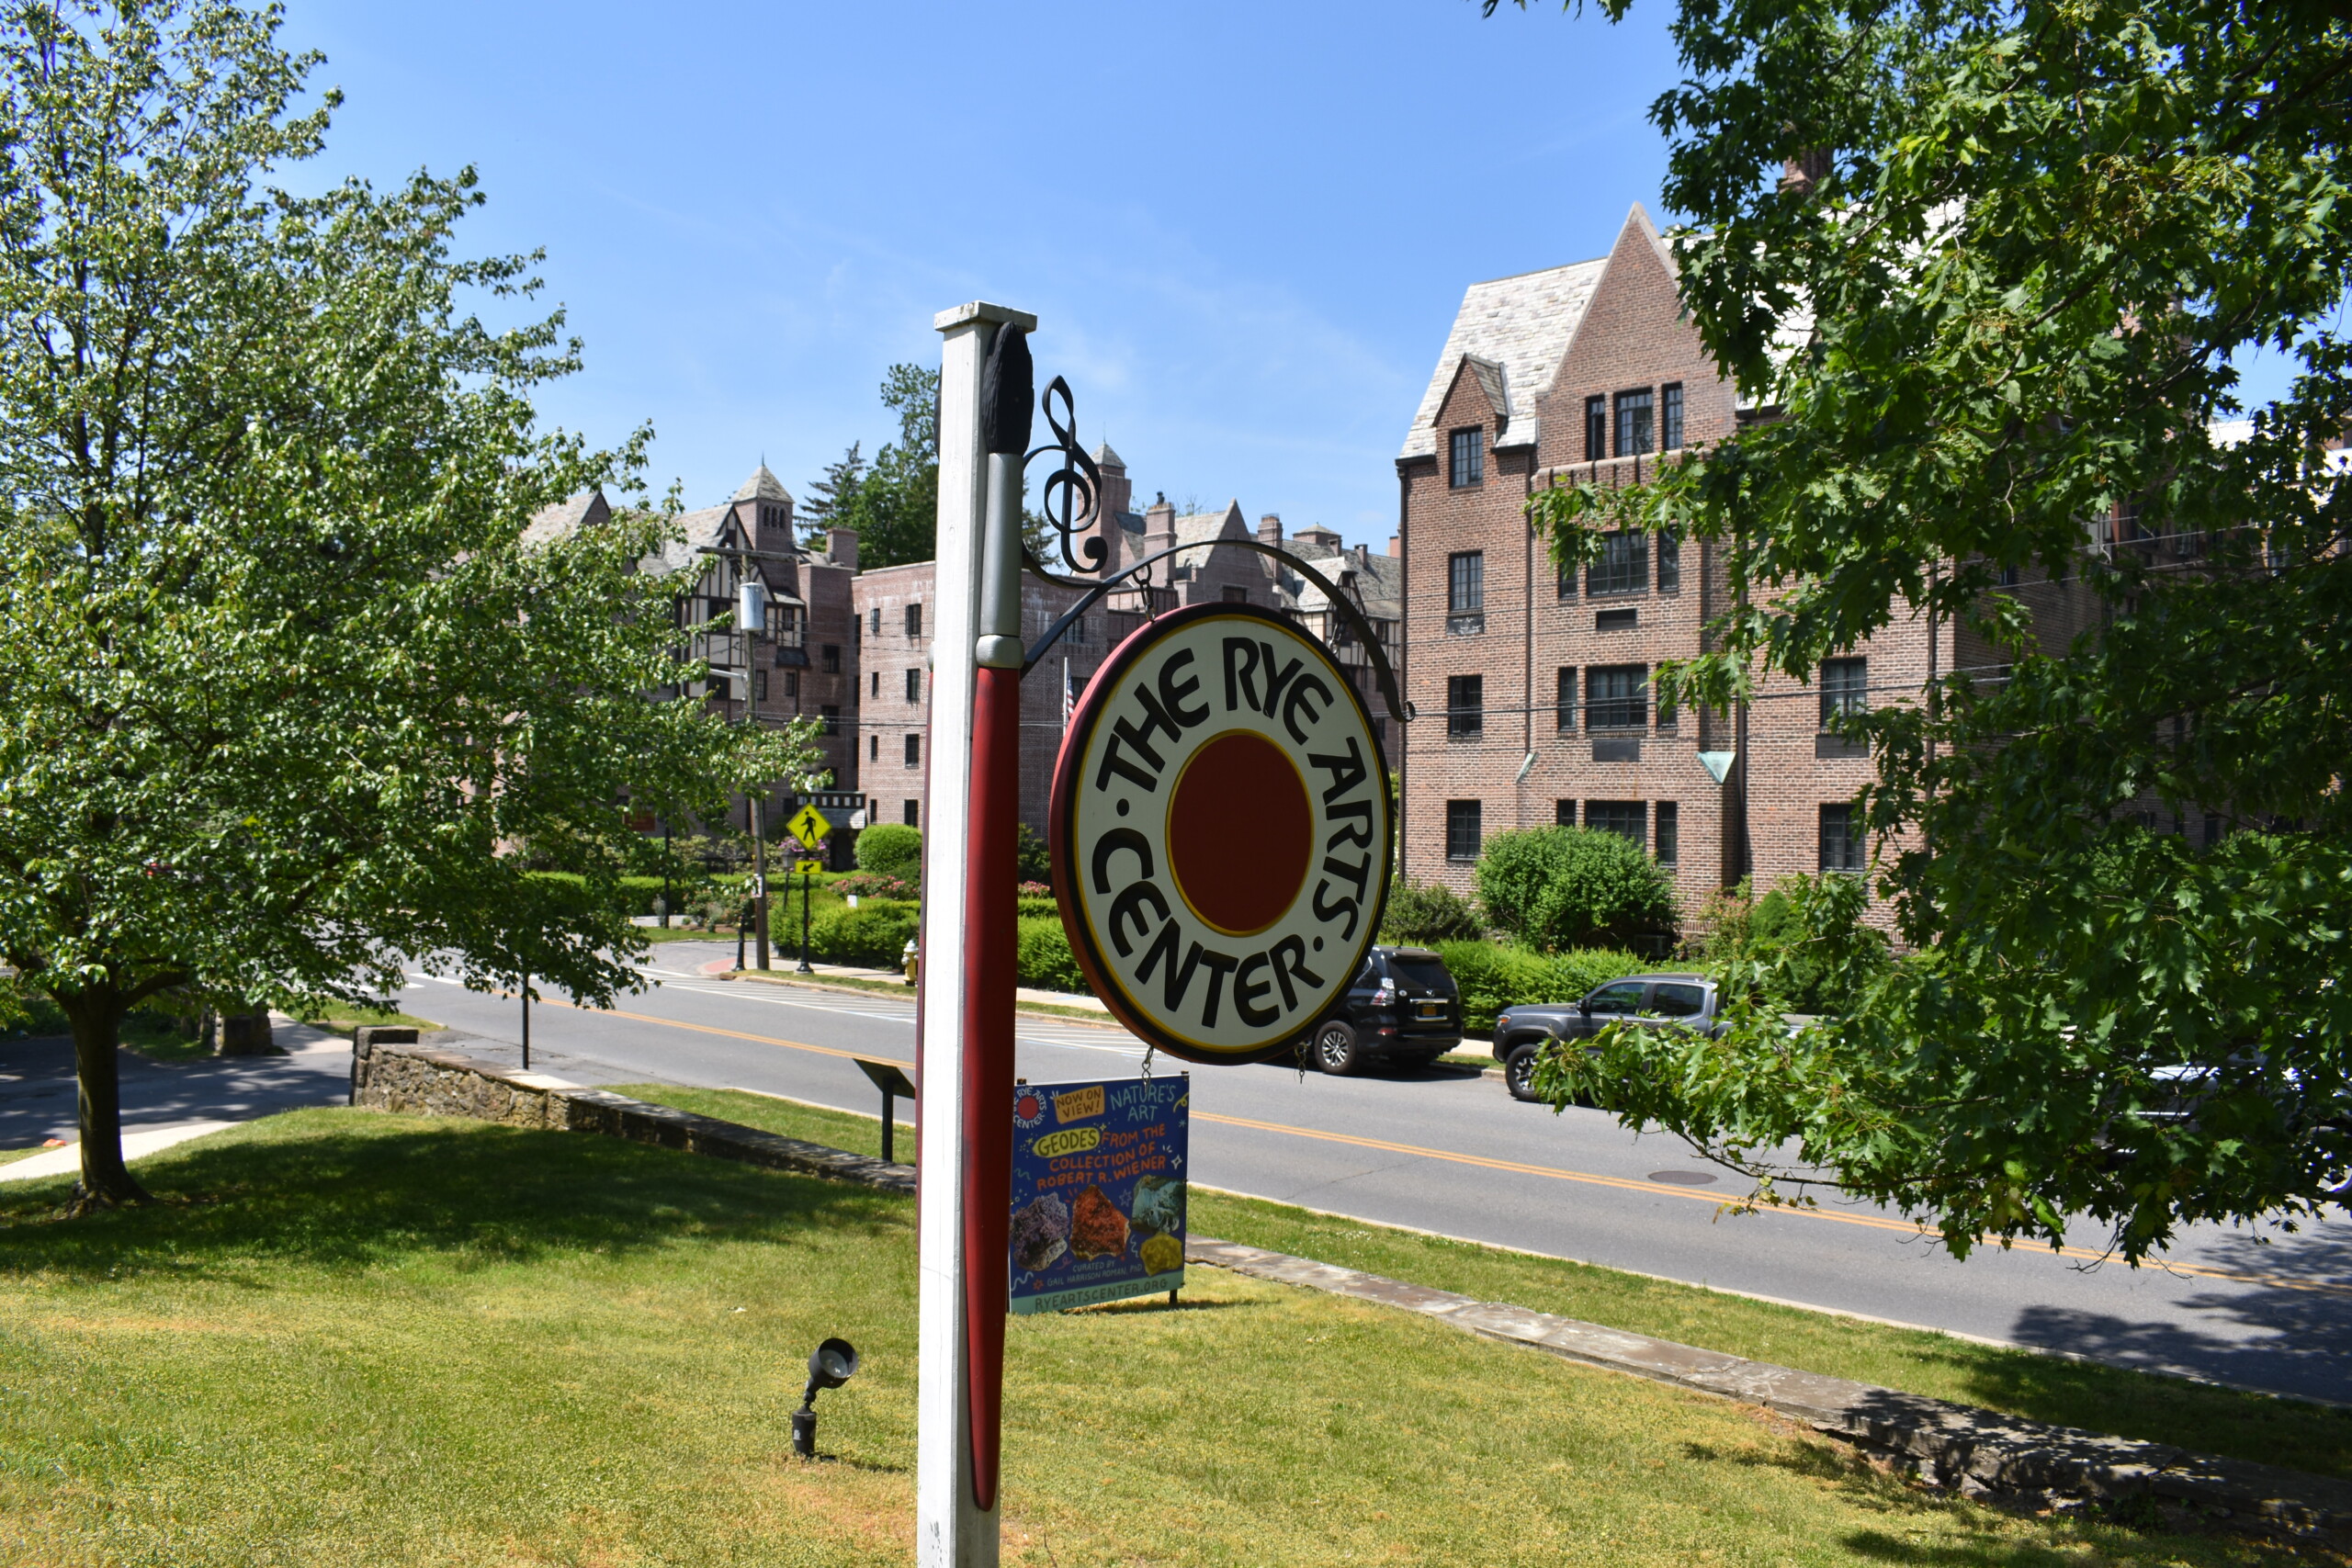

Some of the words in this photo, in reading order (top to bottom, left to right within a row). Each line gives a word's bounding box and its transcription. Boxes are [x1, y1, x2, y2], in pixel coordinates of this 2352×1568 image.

[1095, 647, 1211, 793] THE
[1222, 637, 1335, 746] RYE
[1307, 736, 1374, 942] ARTS
[1091, 827, 1327, 1029] CENTER
[1016, 1086, 1034, 1099] RYE
[1032, 1089, 1047, 1111] ARTS
[1057, 1090, 1083, 1109] NOW
[1086, 1088, 1102, 1100] ON
[1062, 1100, 1101, 1118] VIEW!
[1110, 1084, 1176, 1111] NATURE'S
[1013, 1112, 1046, 1129] CENTER
[1127, 1105, 1158, 1122] ART
[1037, 1129, 1097, 1156] GEODES
[1102, 1132, 1139, 1147] FROM
[1142, 1123, 1166, 1138] THE
[1049, 1148, 1136, 1172] COLLECTION
[1138, 1141, 1156, 1156] OF
[1036, 1171, 1093, 1191] ROBERT
[1098, 1169, 1112, 1184] R.
[1113, 1156, 1166, 1180] WIENER
[1072, 1261, 1104, 1272] CURATED
[1105, 1259, 1115, 1268] BY
[1035, 1278, 1169, 1311] RYEARTSCENTER.ORG
[1046, 1278, 1064, 1287] GAIL
